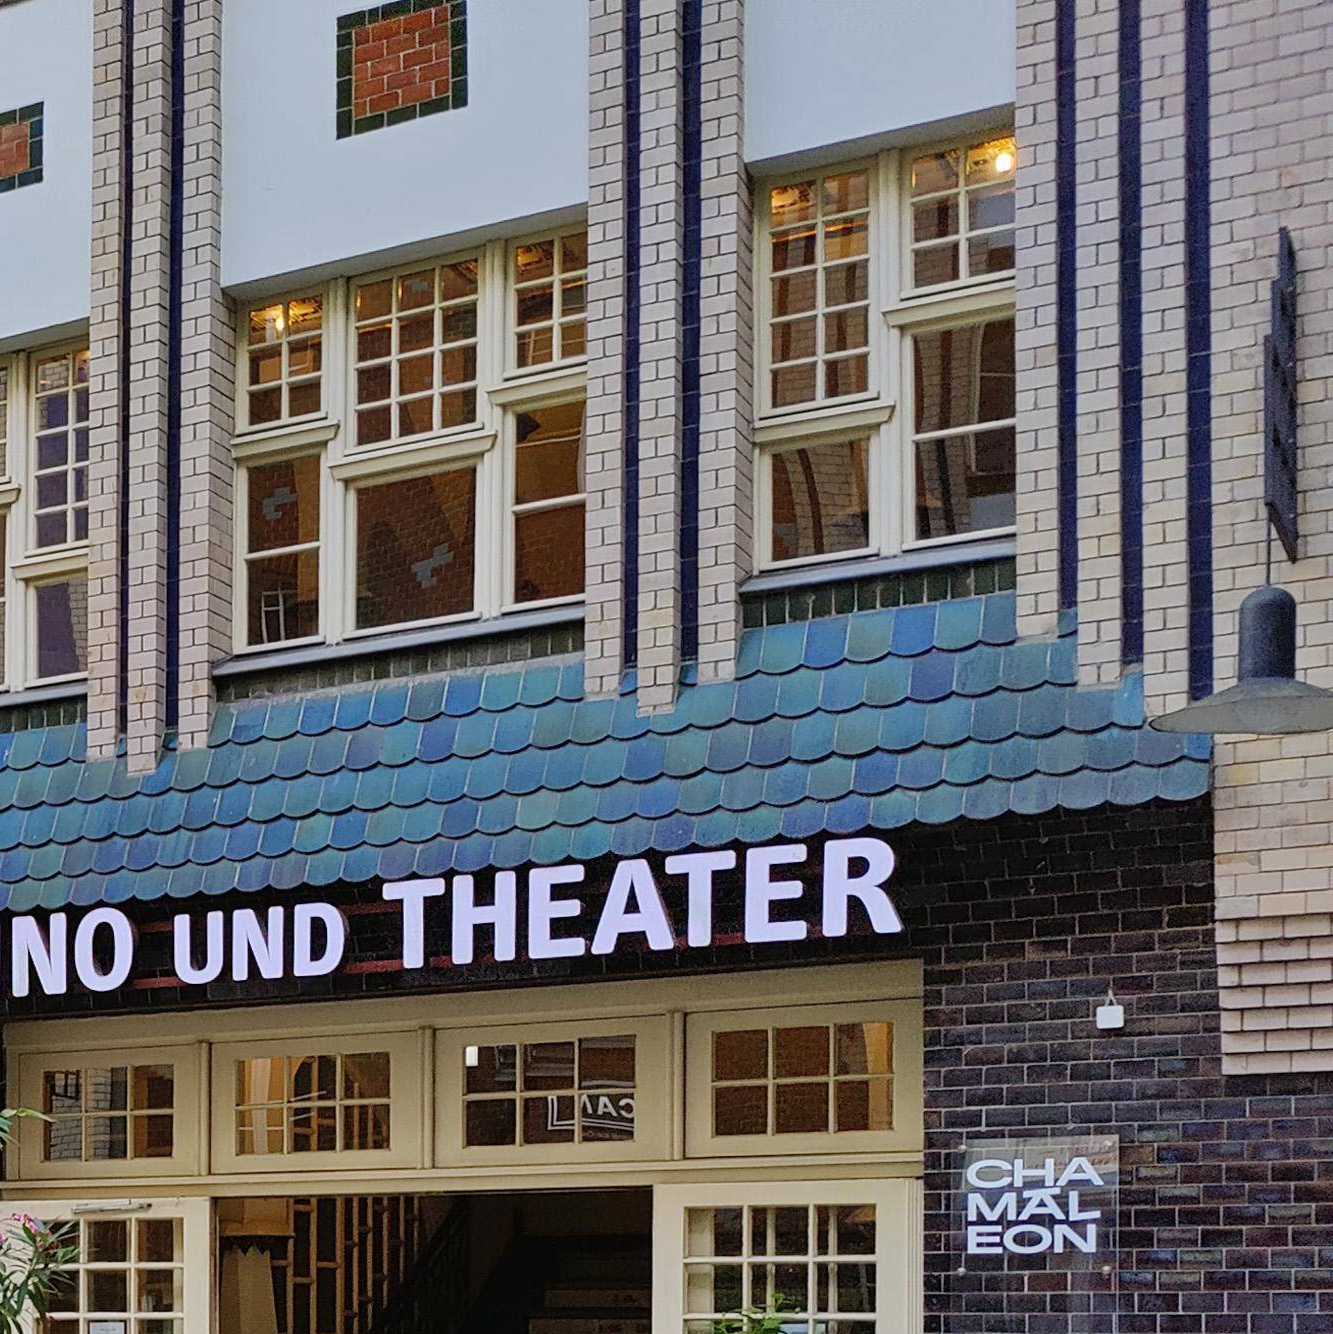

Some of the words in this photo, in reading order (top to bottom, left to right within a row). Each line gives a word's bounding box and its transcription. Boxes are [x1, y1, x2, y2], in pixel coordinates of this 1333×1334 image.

[174, 902, 346, 985] UND
[382, 837, 903, 969] THEATER
[966, 1157, 1104, 1188] CHA
[967, 1224, 1096, 1254] EON
